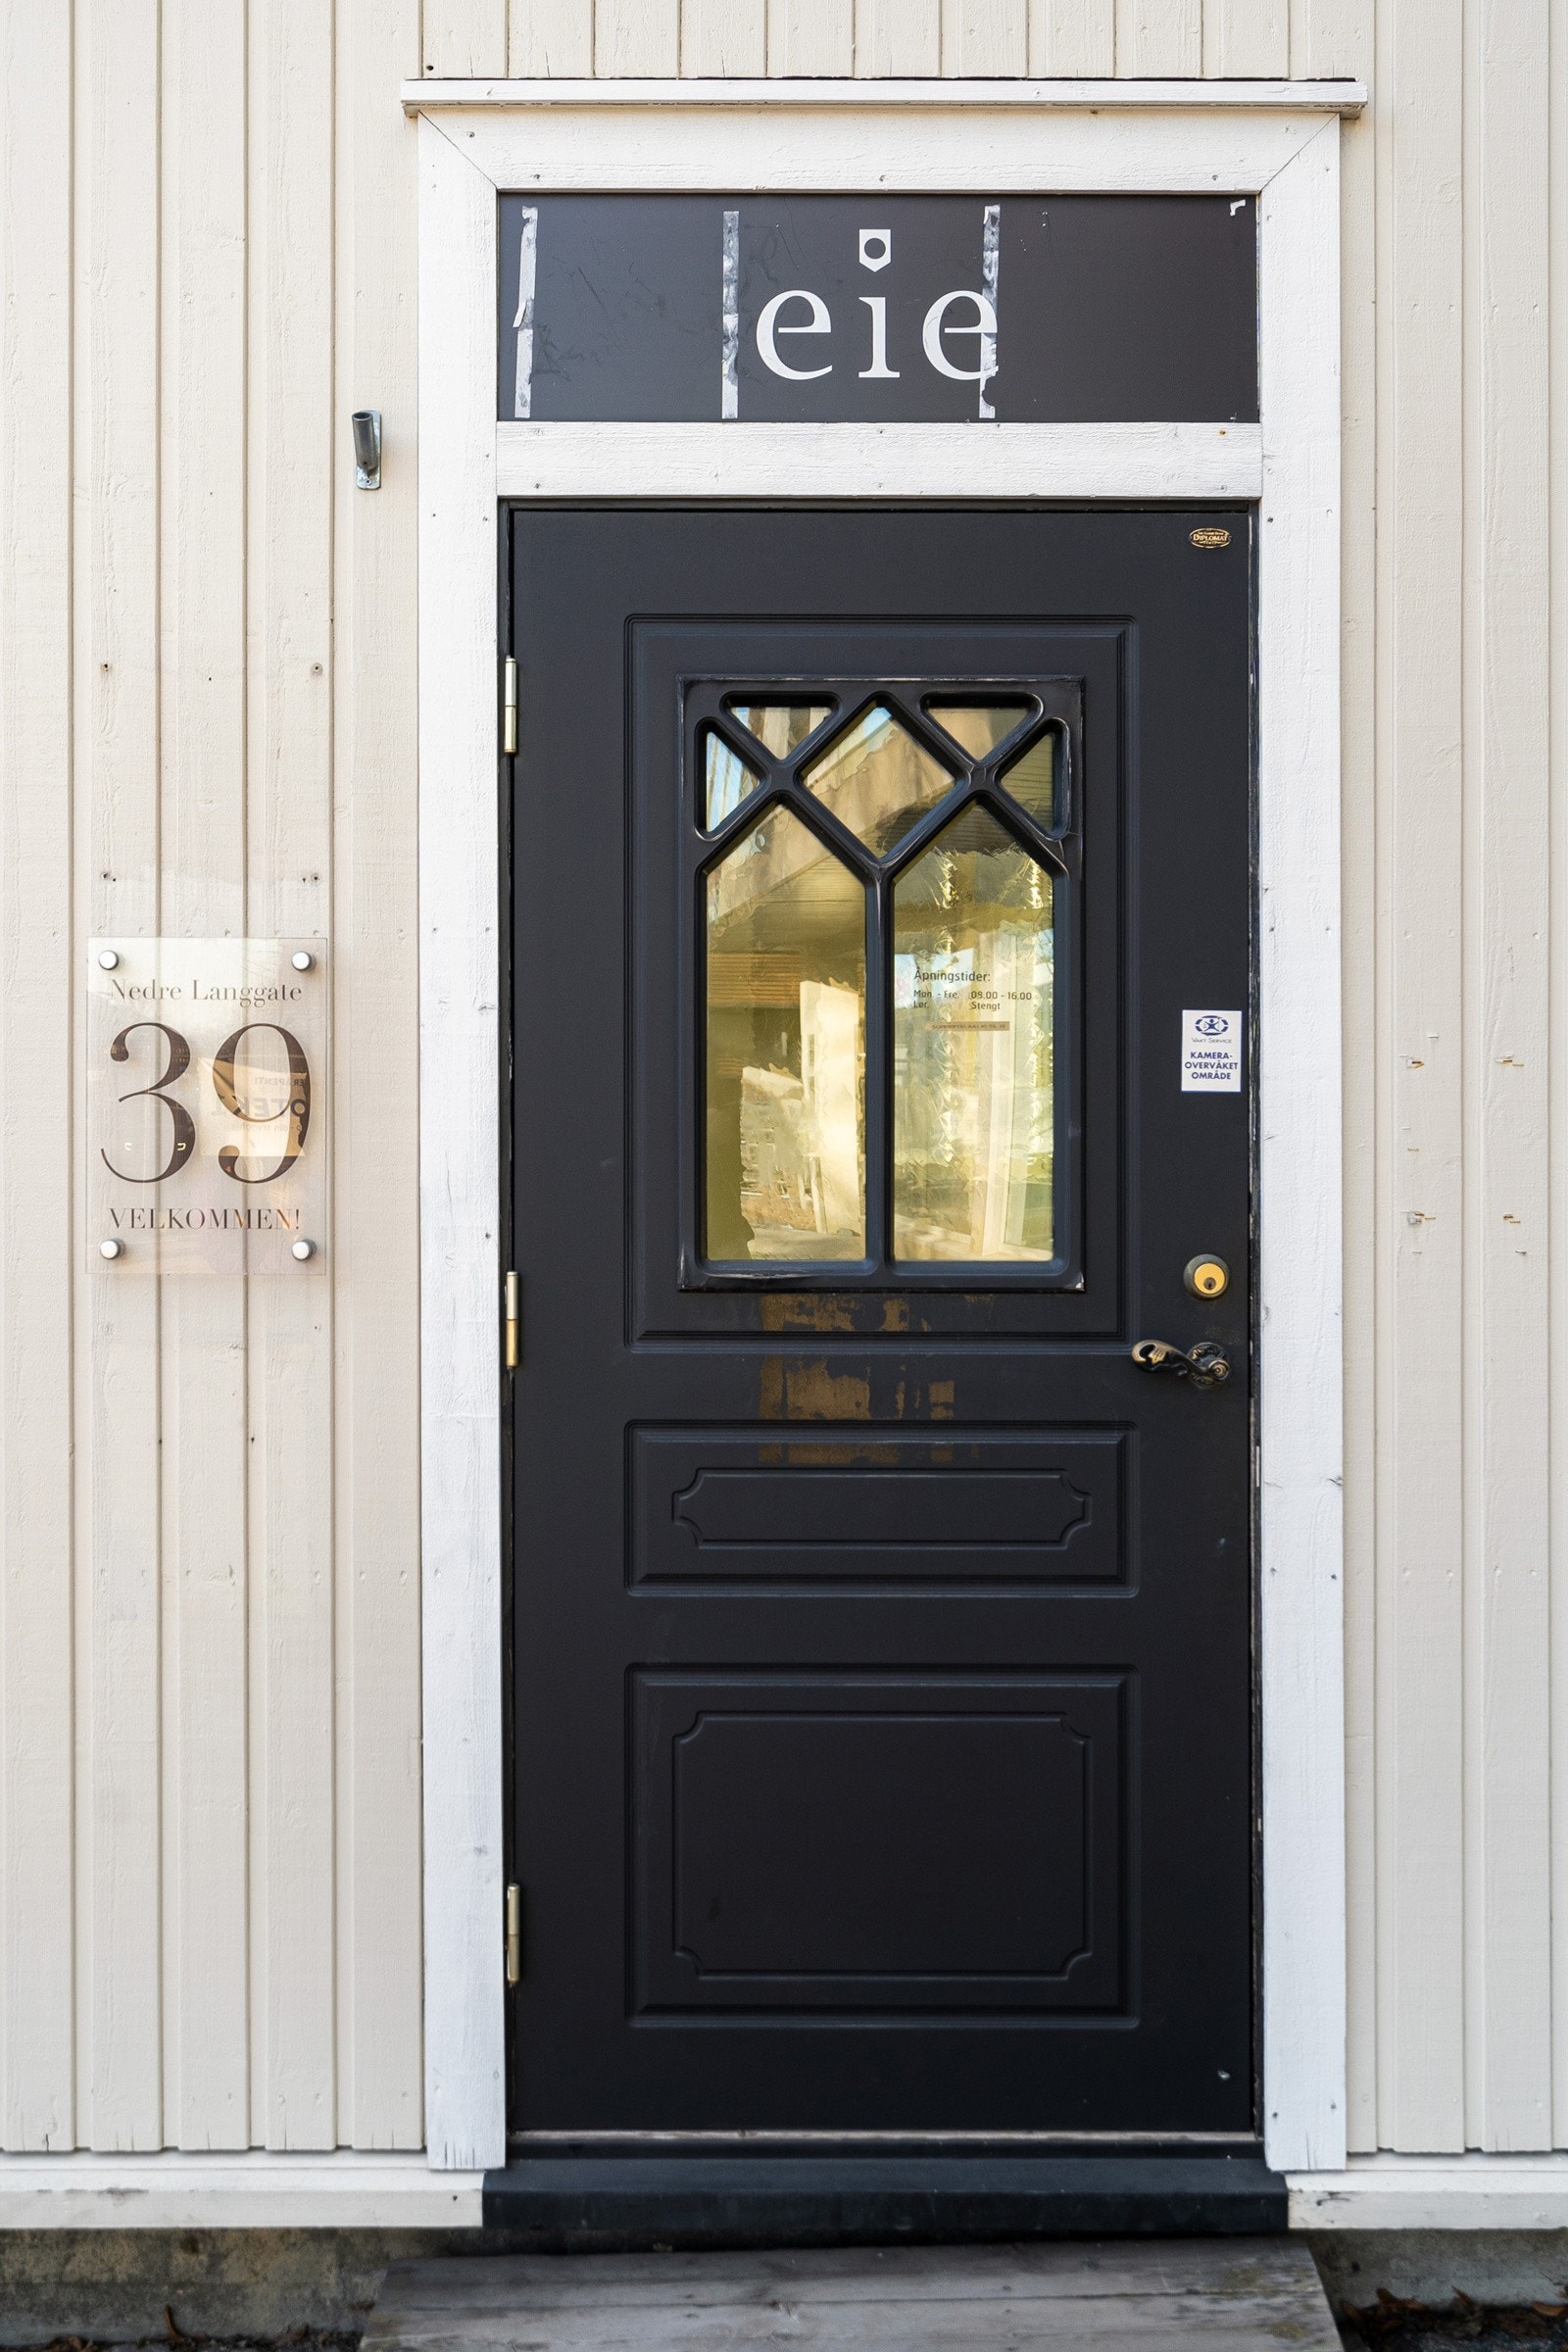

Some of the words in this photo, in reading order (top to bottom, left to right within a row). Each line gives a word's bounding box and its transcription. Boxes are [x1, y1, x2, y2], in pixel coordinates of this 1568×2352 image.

[755, 228, 998, 381] eie
[913, 966, 991, 983] Åpningstider:
[111, 979, 182, 1001] Nedre
[192, 979, 303, 1008] Langgate
[1007, 992, 1032, 1001] 16.00
[970, 1001, 1001, 1012] Stengt
[1184, 1060, 1238, 1070] OVERVÅKET
[1191, 1070, 1231, 1080] OMRÅDE
[101, 1021, 312, 1184] 39
[110, 1207, 300, 1230] VELKOMMEN!
